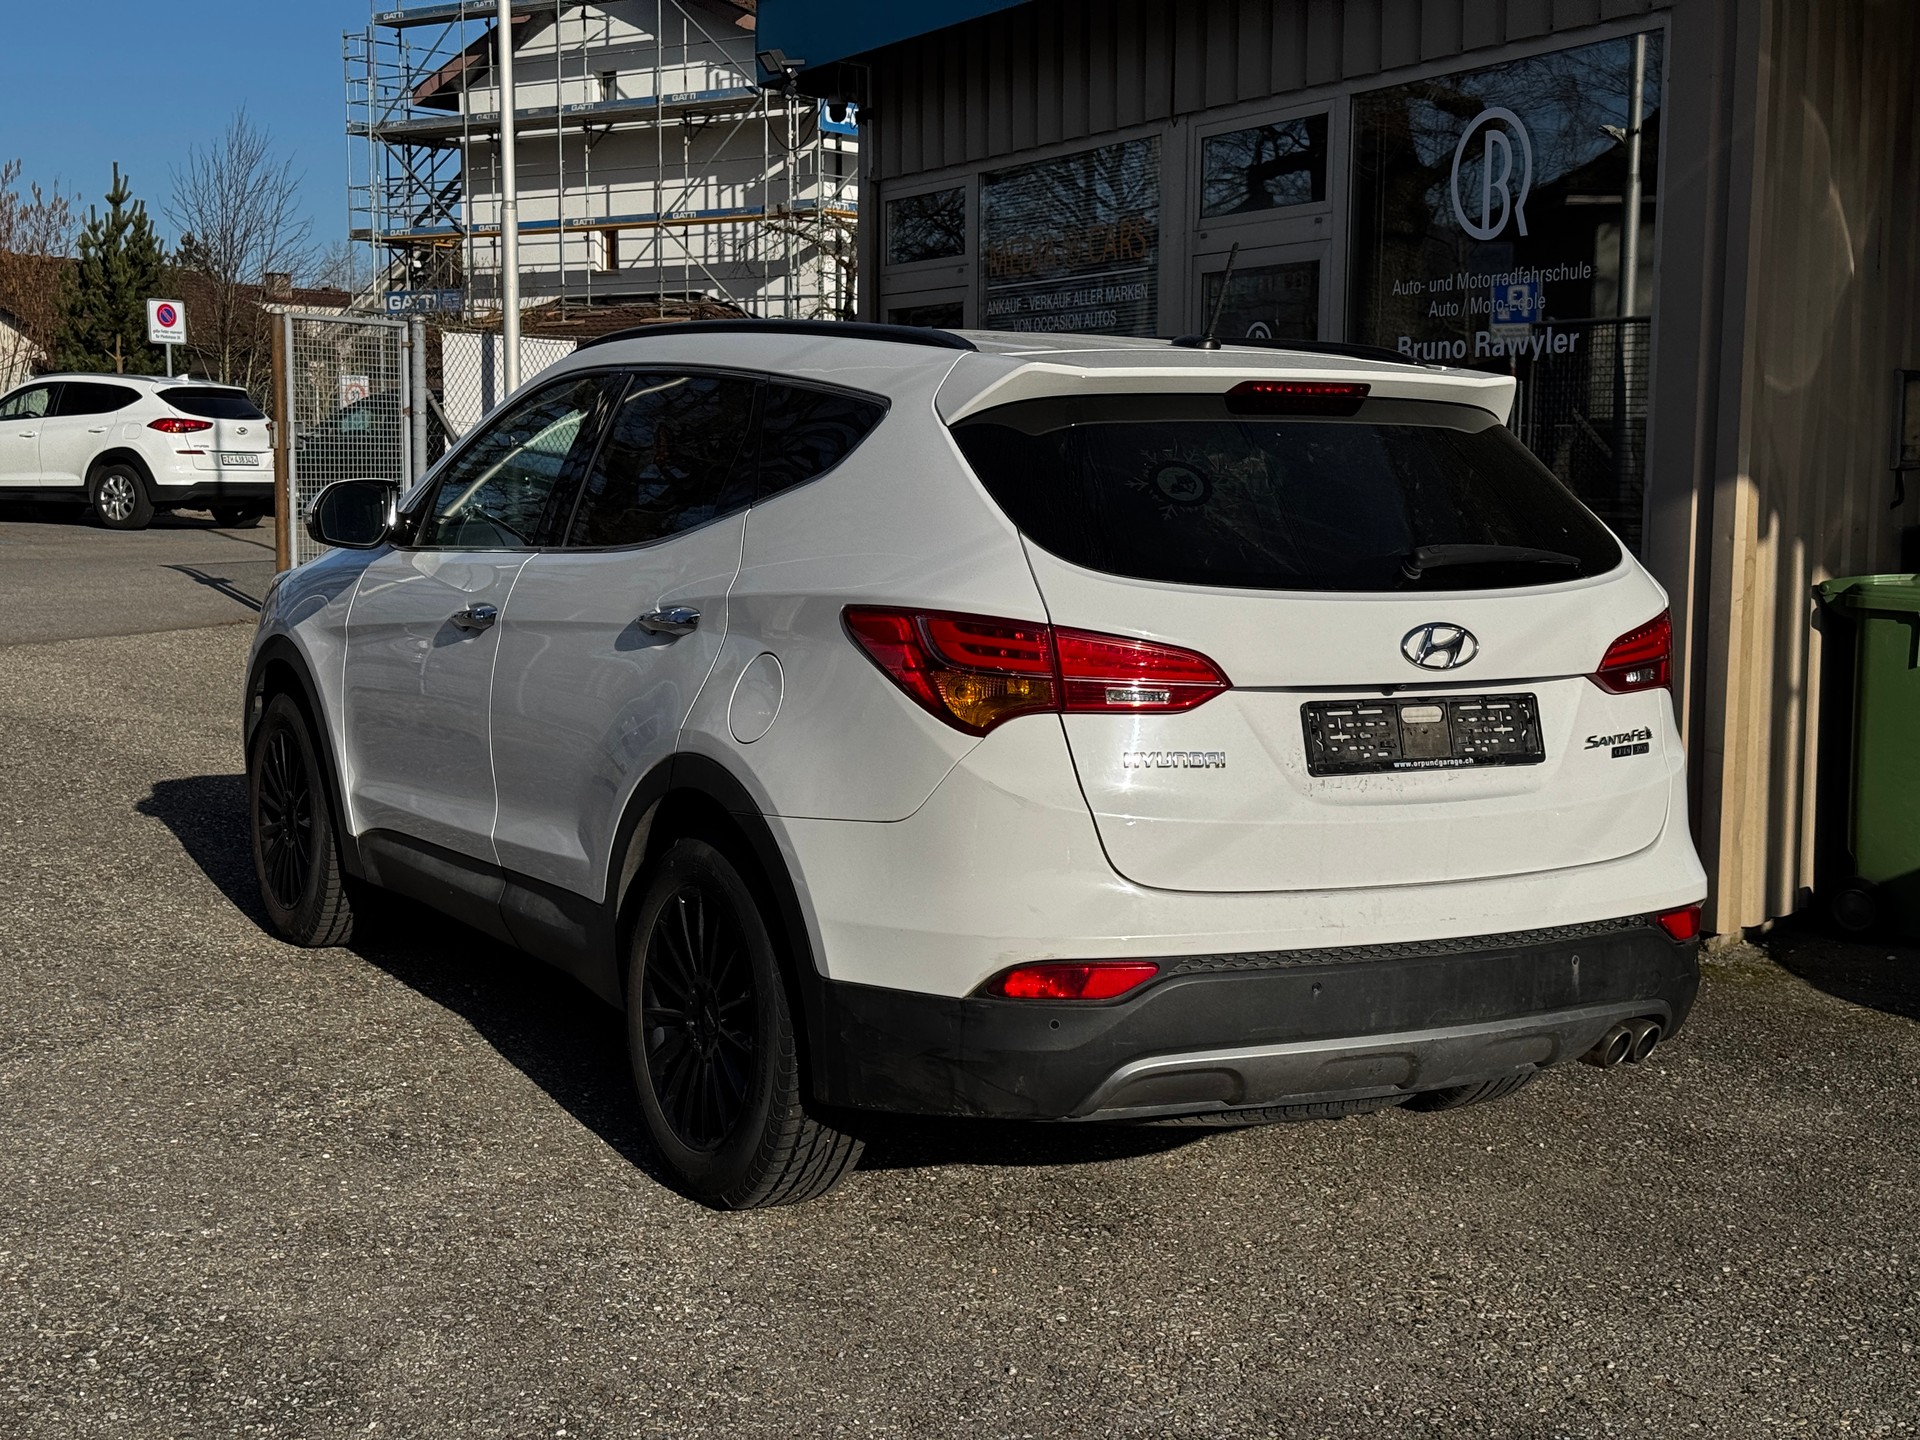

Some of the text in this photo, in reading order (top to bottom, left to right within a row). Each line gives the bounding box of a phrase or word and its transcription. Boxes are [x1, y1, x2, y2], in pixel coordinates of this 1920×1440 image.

[383, 11, 404, 20] GATTI
[672, 93, 696, 102] GATTI
[571, 103, 594, 112] GATTI
[476, 113, 498, 121] GATTI
[672, 211, 697, 219] GATTI
[572, 218, 596, 226] GATTI
[478, 224, 500, 232] GATTI
[1089, 217, 1148, 263] CARS
[1391, 261, 1592, 296] Auto- und Motorradfahrschule
[987, 297, 1022, 316] ANKAUF
[1029, 292, 1071, 311] VERKAUF
[1073, 288, 1103, 305] ALLER
[1105, 283, 1149, 302] MARKEN
[1428, 300, 1459, 318] Auto
[1013, 310, 1117, 332] VON OCCASION AUTOS
[1397, 327, 1580, 361] Bruno Rawyler
[1123, 752, 1226, 769] HYUNDAI
[1393, 757, 1474, 768] www.orpundgarage.ch
